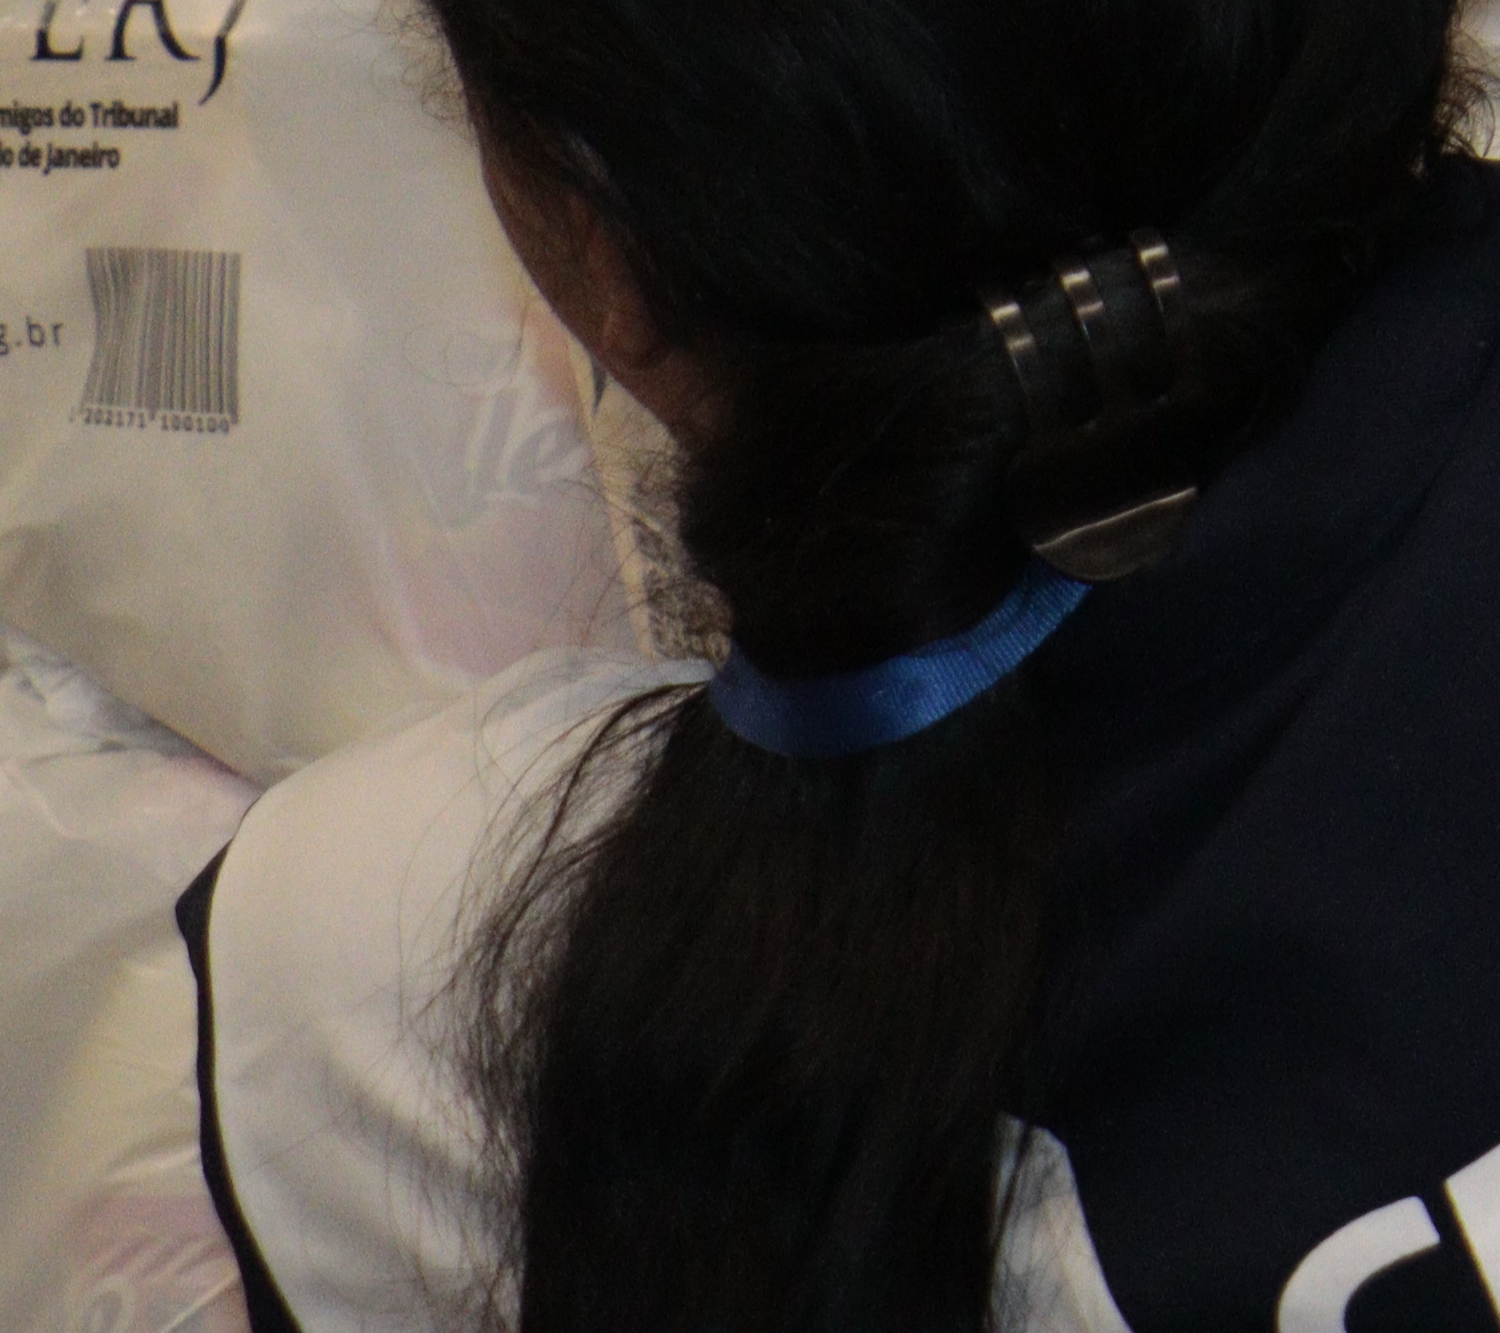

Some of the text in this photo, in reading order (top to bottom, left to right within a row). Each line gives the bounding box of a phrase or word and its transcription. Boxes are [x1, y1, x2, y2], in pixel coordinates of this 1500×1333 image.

[60, 99, 85, 127] do
[91, 99, 179, 128] Tribunal
[19, 141, 42, 168] de
[42, 140, 121, 175] Janeiro
